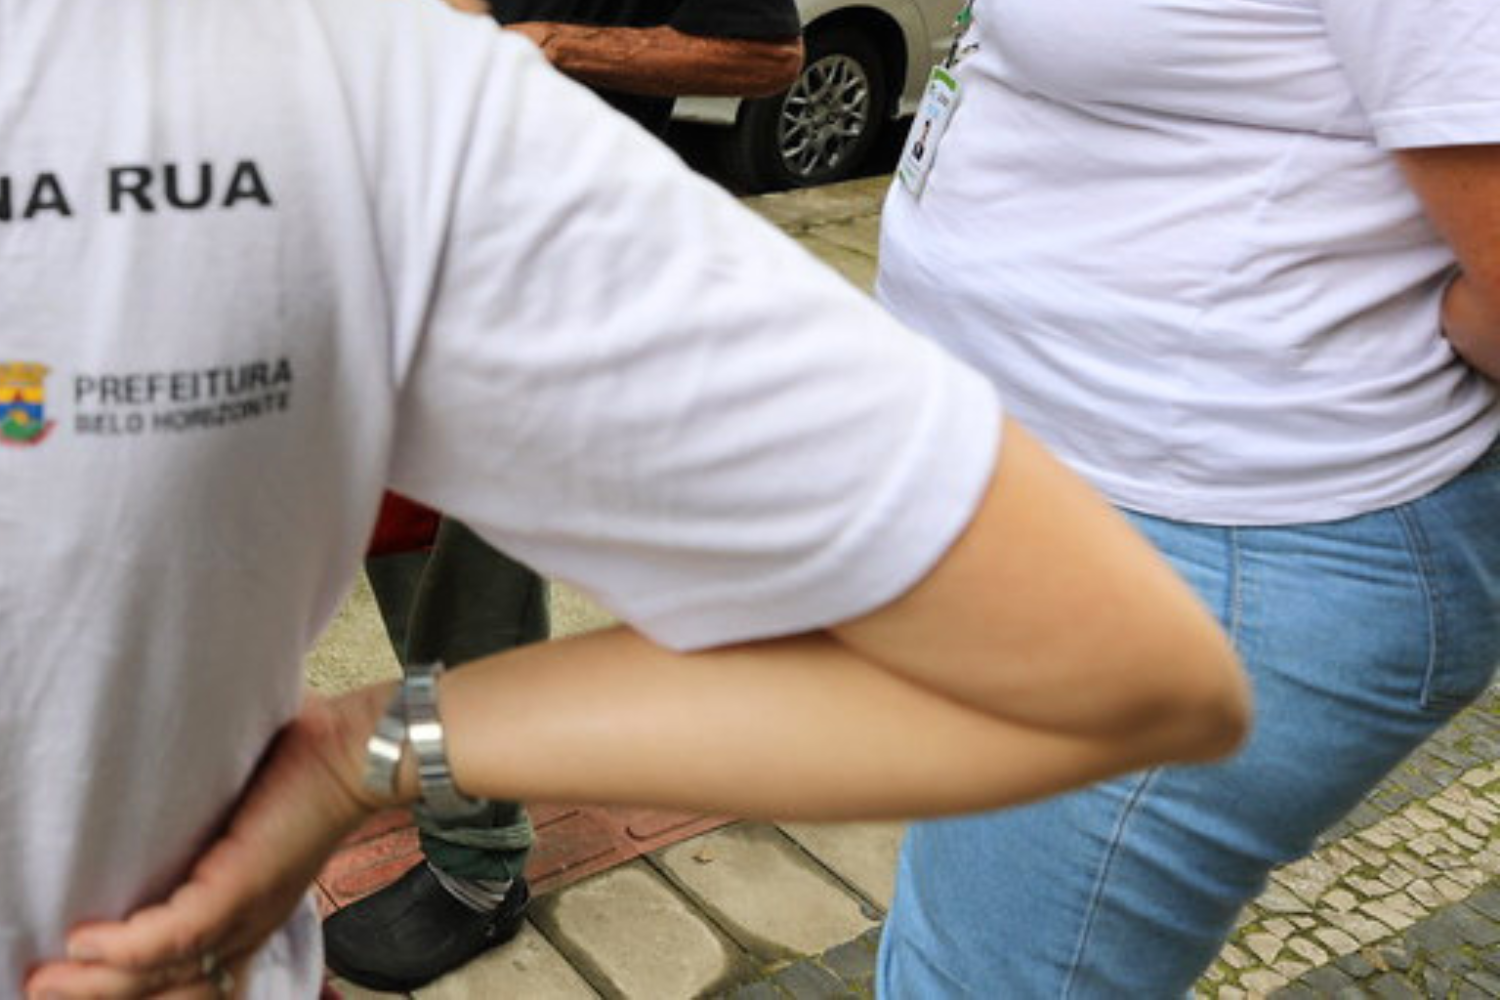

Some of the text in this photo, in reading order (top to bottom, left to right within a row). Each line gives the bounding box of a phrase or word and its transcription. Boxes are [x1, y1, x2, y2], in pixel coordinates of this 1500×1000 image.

[107, 159, 273, 213] RUA
[74, 356, 292, 405] PREFEITURA
[74, 412, 145, 435] BELO
